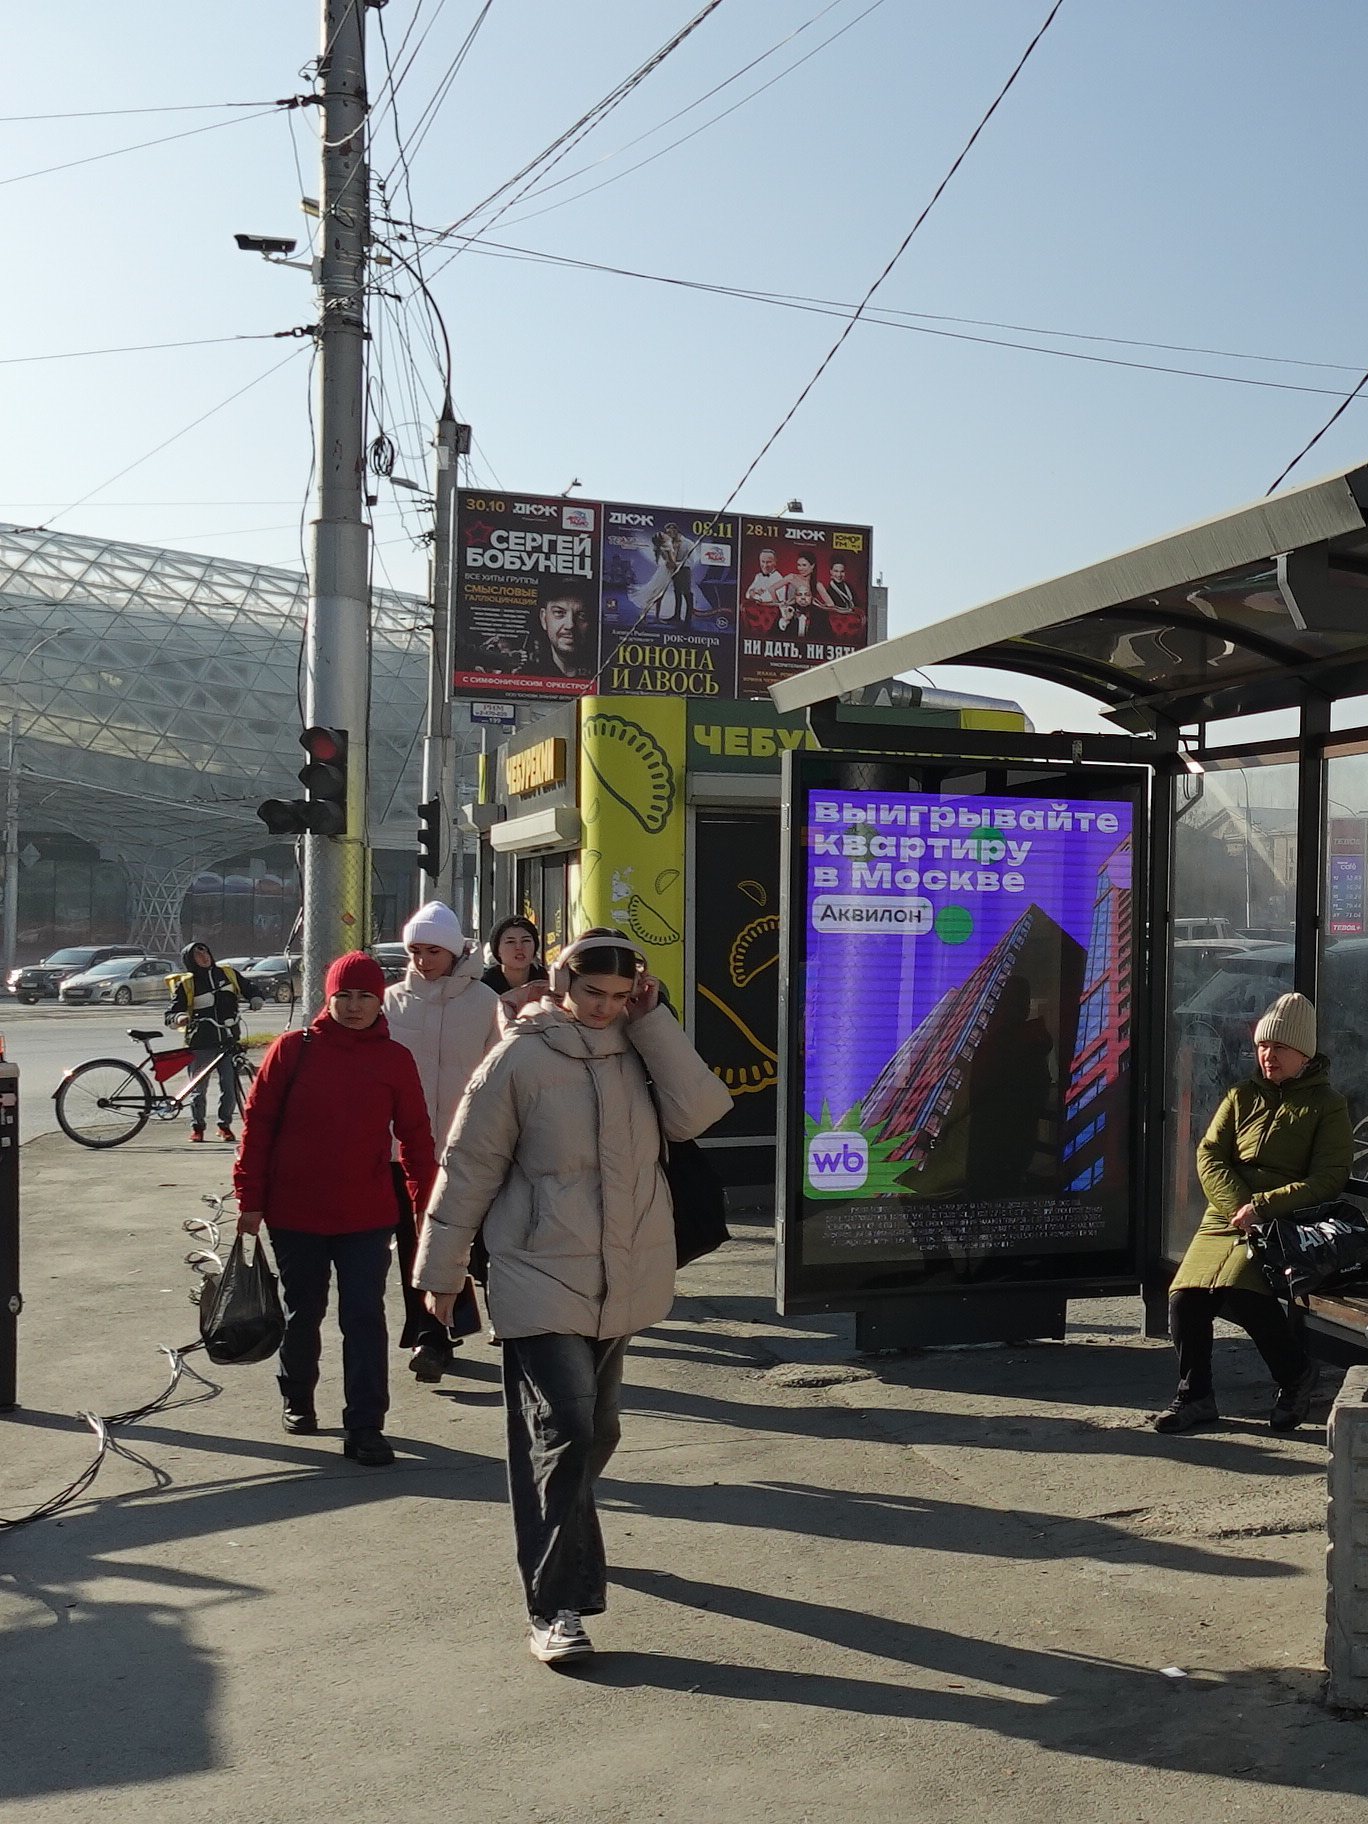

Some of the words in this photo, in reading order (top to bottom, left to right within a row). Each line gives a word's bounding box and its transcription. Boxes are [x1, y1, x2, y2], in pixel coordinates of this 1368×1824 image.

[466, 498, 505, 512] 30.10
[692, 521, 732, 538] 08.11
[746, 524, 779, 537] 28.11
[490, 530, 592, 556] СЕРГЕЙ
[466, 547, 593, 579] БОБУНЕЦ
[464, 584, 538, 597] СМЫСЛОВЫЕ
[506, 576, 538, 584] ГРУППЫ
[663, 634, 720, 647] рок-опера
[744, 639, 761, 655] НИ
[807, 644, 824, 660] НИ
[827, 645, 855, 660] ЗЯТ
[617, 644, 715, 671] ЮНОНА
[611, 668, 631, 689] И
[638, 669, 720, 694] АВОСЬ
[814, 801, 1120, 834] выигрывайте
[814, 832, 1033, 867] квартиру
[813, 867, 839, 888] в
[851, 862, 1026, 892] Москве
[820, 903, 922, 924] Аквилон
[813, 1144, 864, 1173] wb
